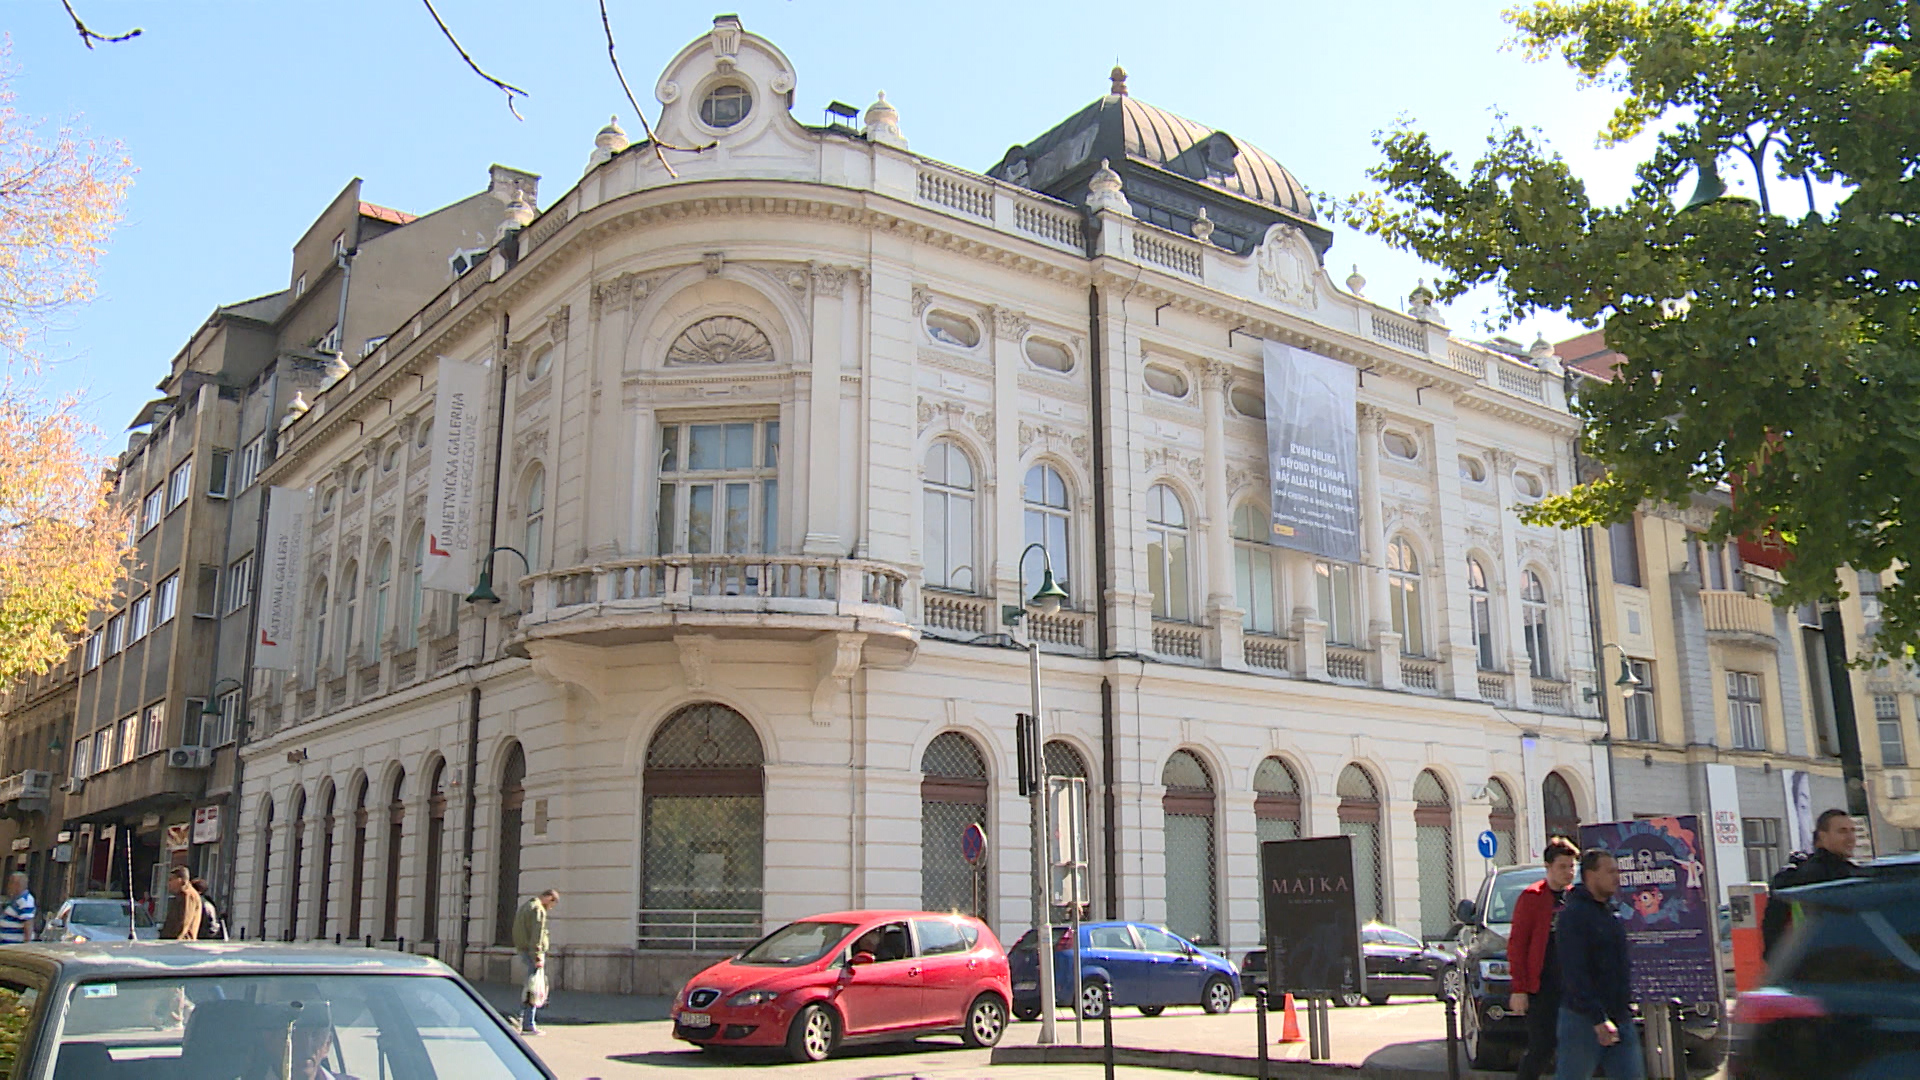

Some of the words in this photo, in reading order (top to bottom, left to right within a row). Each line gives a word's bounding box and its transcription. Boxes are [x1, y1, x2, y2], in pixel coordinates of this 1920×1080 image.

[447, 392, 465, 457] GALERIJA
[1290, 443, 1311, 457] IZVAN
[1280, 457, 1310, 473] BEYOND
[1310, 464, 1323, 477] THE
[1319, 481, 1328, 493] LA
[441, 460, 459, 547] UMJETNIČKA
[276, 533, 289, 582] GALLERY
[1272, 876, 1349, 896] MAJKA
